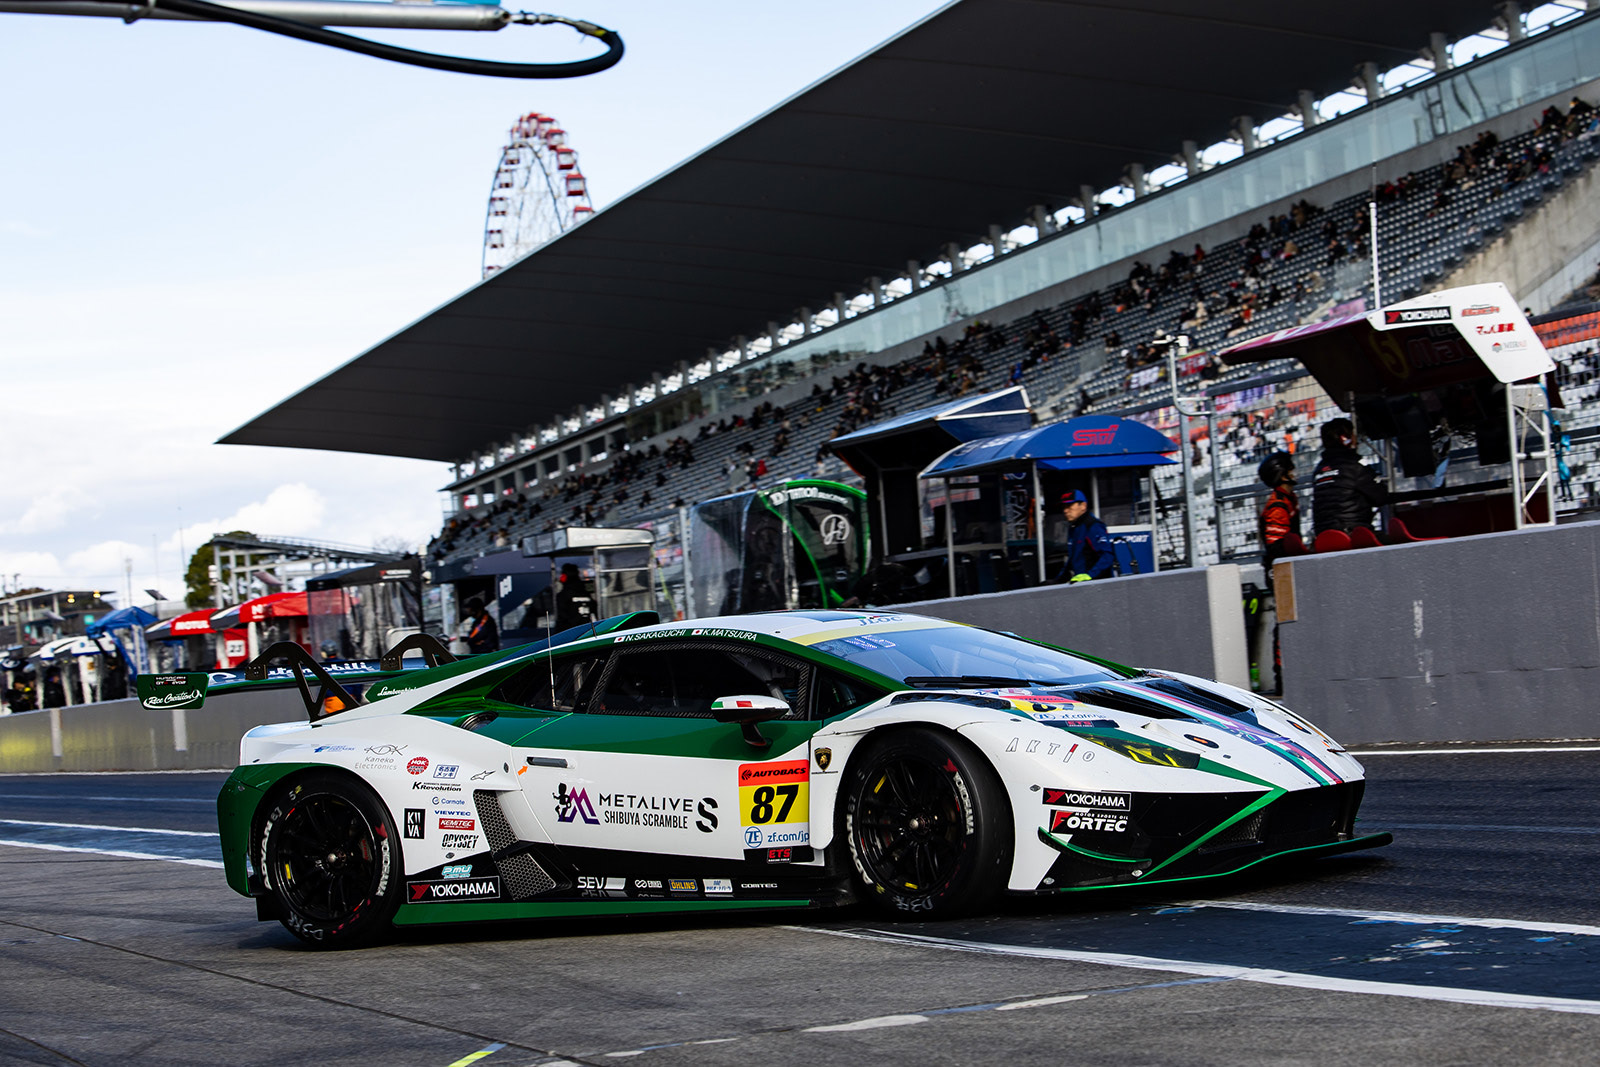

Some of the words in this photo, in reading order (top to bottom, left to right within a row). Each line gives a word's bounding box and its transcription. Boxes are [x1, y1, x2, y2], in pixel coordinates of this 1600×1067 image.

[1400, 308, 1449, 321] YOKOHAMA
[860, 616, 903, 626] JLOC
[625, 629, 686, 642] N.SAKAGUCHI
[703, 628, 758, 641] K.MATSUURA
[1006, 737, 1095, 763] AKTIO
[354, 762, 398, 771] Electronics
[364, 756, 394, 764] Kaneko
[753, 768, 806, 777] AUTOBACS
[599, 793, 693, 812] METALIVE
[751, 784, 799, 824] 87
[1065, 793, 1126, 807] YOKOHAMA
[440, 819, 473, 827] KEMITEC
[604, 810, 640, 825] SHIBUYA
[643, 813, 688, 829] SCRAMBLE
[1051, 811, 1128, 832] FORTEC
[442, 833, 479, 848] ODYSSEY
[746, 829, 762, 846] ZF
[767, 831, 809, 843] zf.com/jp
[769, 849, 791, 858] ETS
[430, 882, 496, 897] YOKOHAMA
[577, 877, 604, 889] SEV
